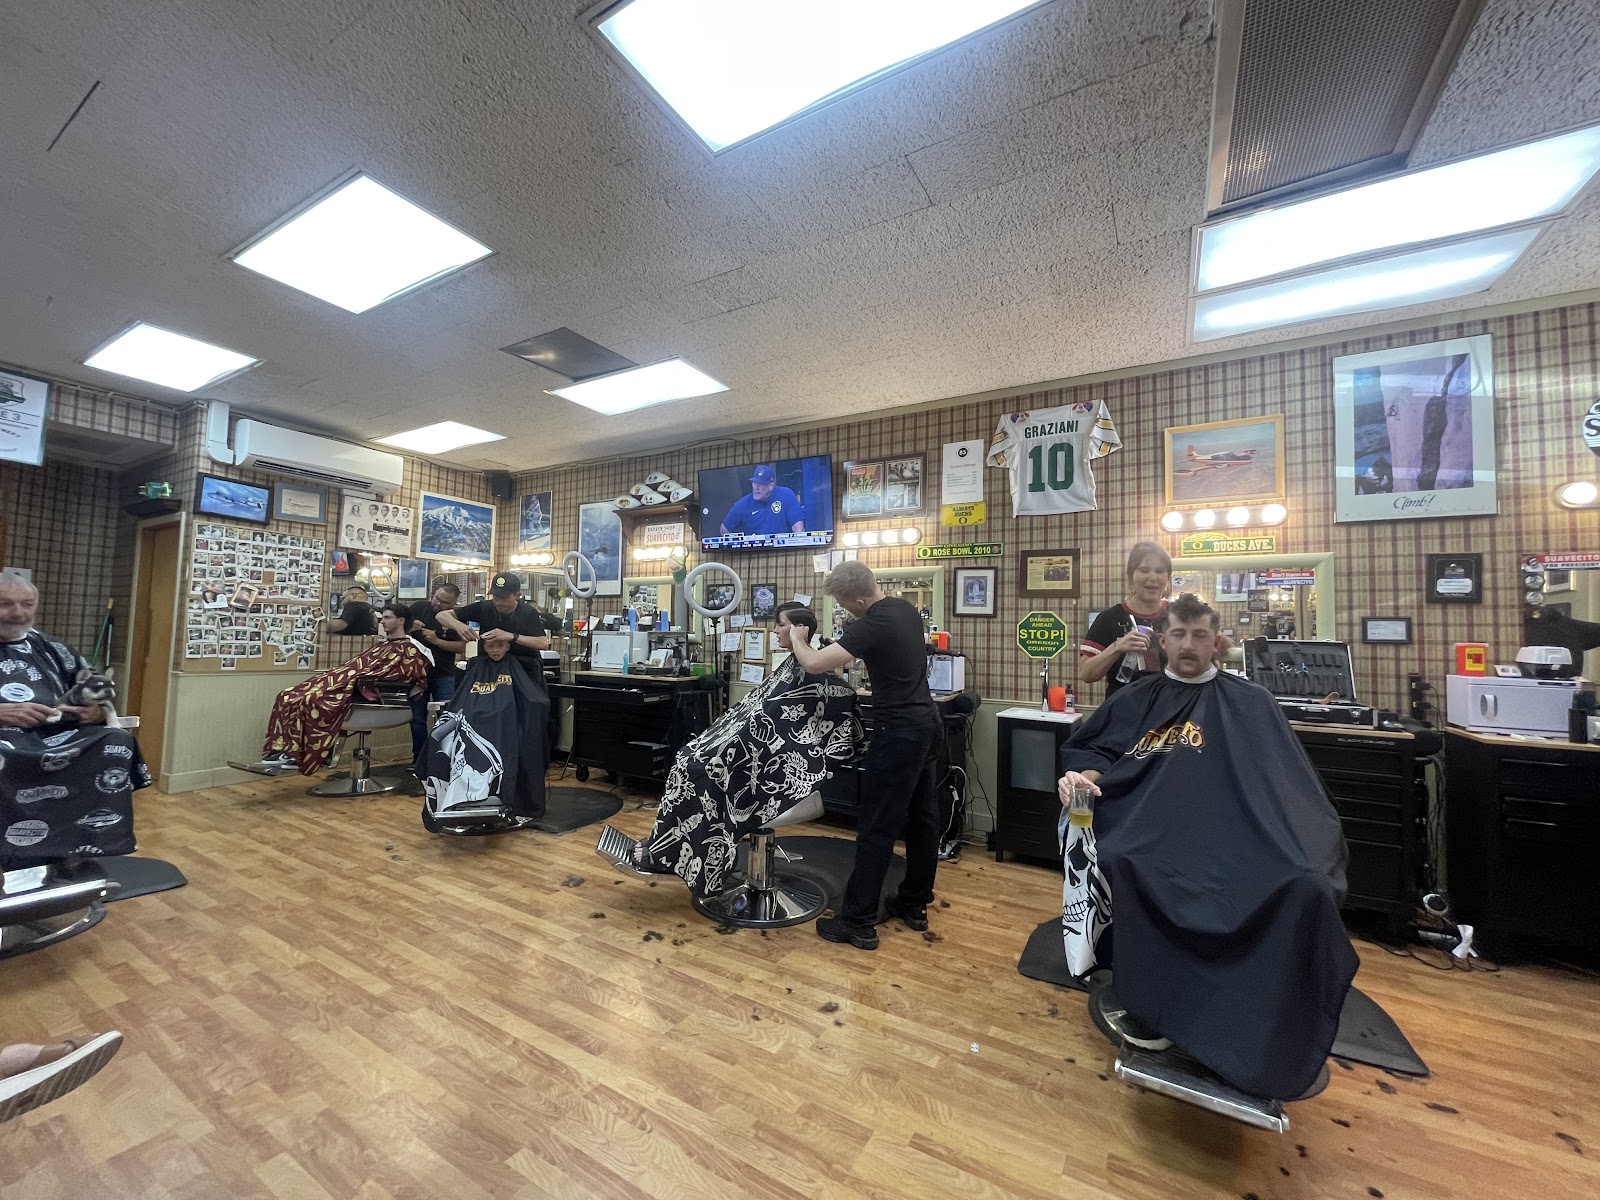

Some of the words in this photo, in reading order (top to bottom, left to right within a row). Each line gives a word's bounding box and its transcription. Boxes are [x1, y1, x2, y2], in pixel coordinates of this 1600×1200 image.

[1025, 420, 1078, 438] GRAZIANI
[1028, 442, 1074, 492] 10
[1393, 495, 1436, 510] Climb!
[646, 533, 674, 542] SUAVECITO
[933, 548, 951, 557] ROSE
[952, 547, 972, 556] BOWL
[974, 546, 991, 555] 2010
[1213, 540, 1246, 552] DUCKS
[1544, 554, 1600, 563] SUAVECITO
[1019, 629, 1064, 640] STOP!
